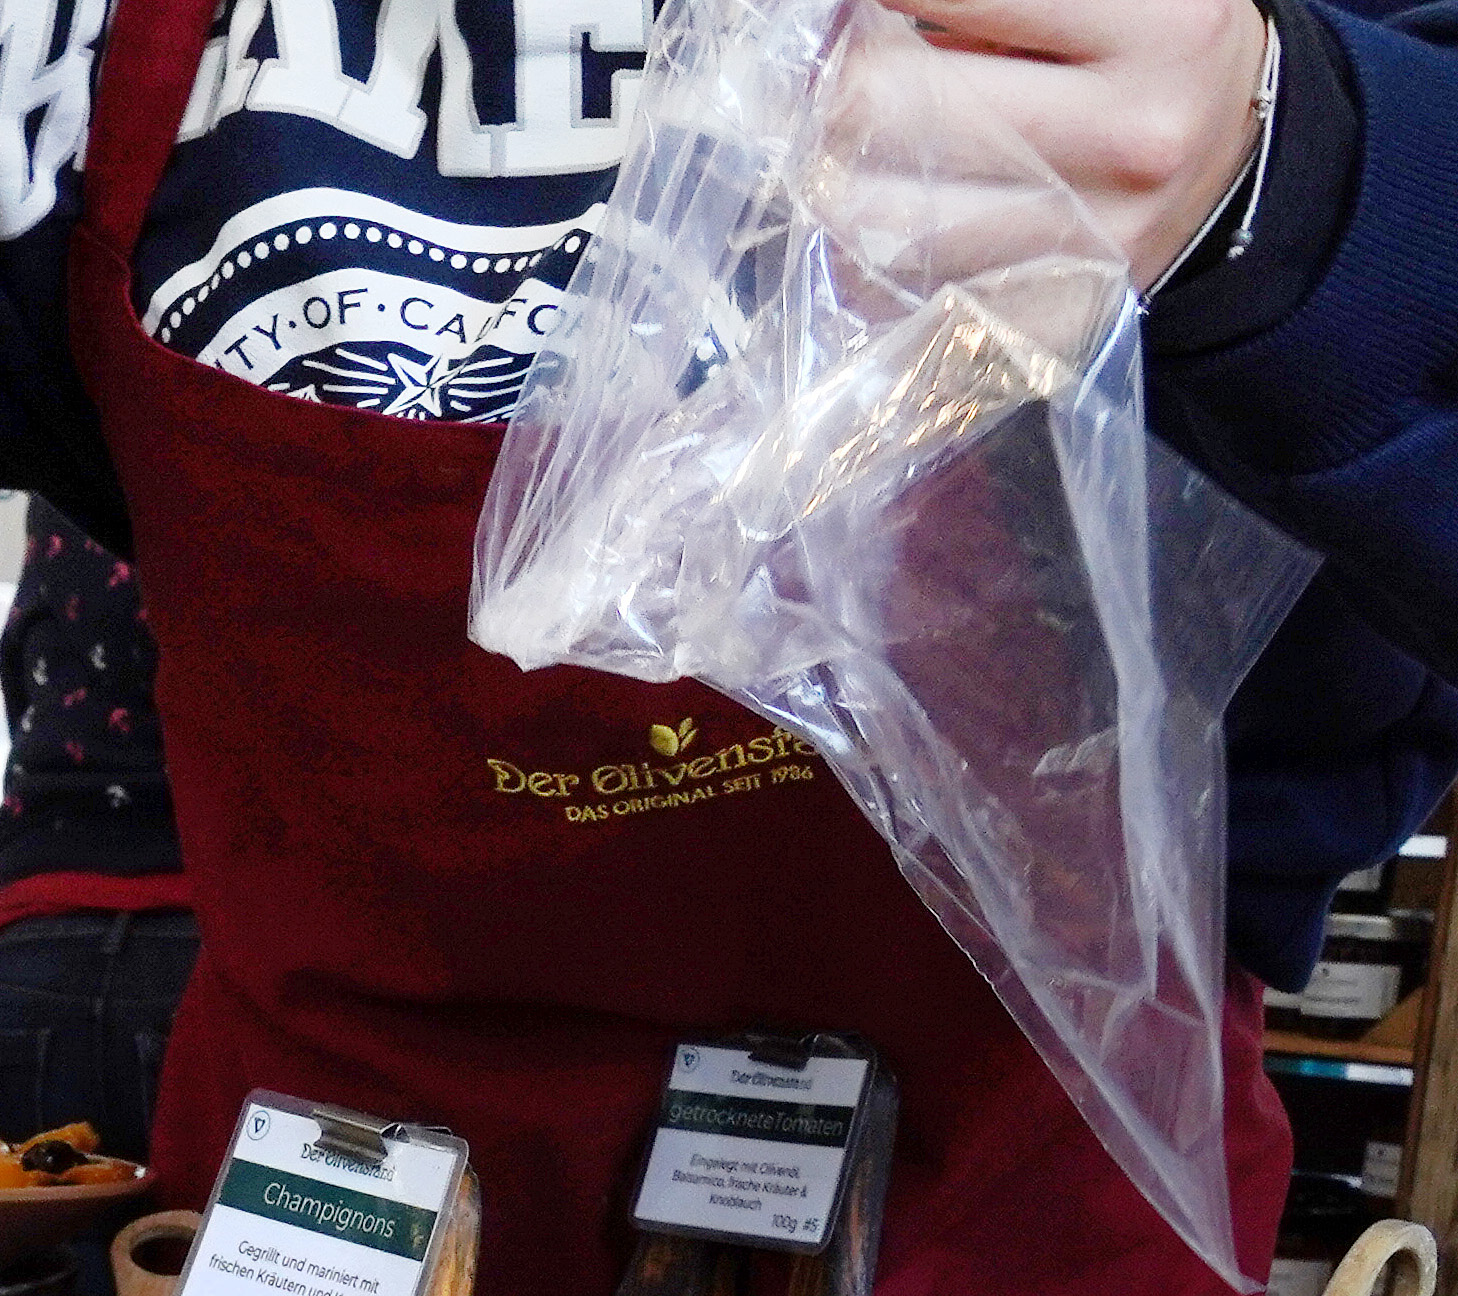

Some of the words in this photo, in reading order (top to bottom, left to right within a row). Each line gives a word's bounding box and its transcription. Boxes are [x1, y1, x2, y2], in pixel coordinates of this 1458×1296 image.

[487, 758, 580, 797] Der
[564, 804, 608, 823] DAS
[612, 785, 716, 815] ORIGINAL
[722, 773, 762, 795] SEIT
[771, 764, 815, 784] 1986
[263, 1182, 396, 1239] Champignons
[208, 1254, 256, 1280] frischen
[238, 1240, 281, 1265] Gegrillt
[282, 1254, 306, 1273] und
[307, 1262, 360, 1290] mariniert
[362, 1276, 381, 1295] mit
